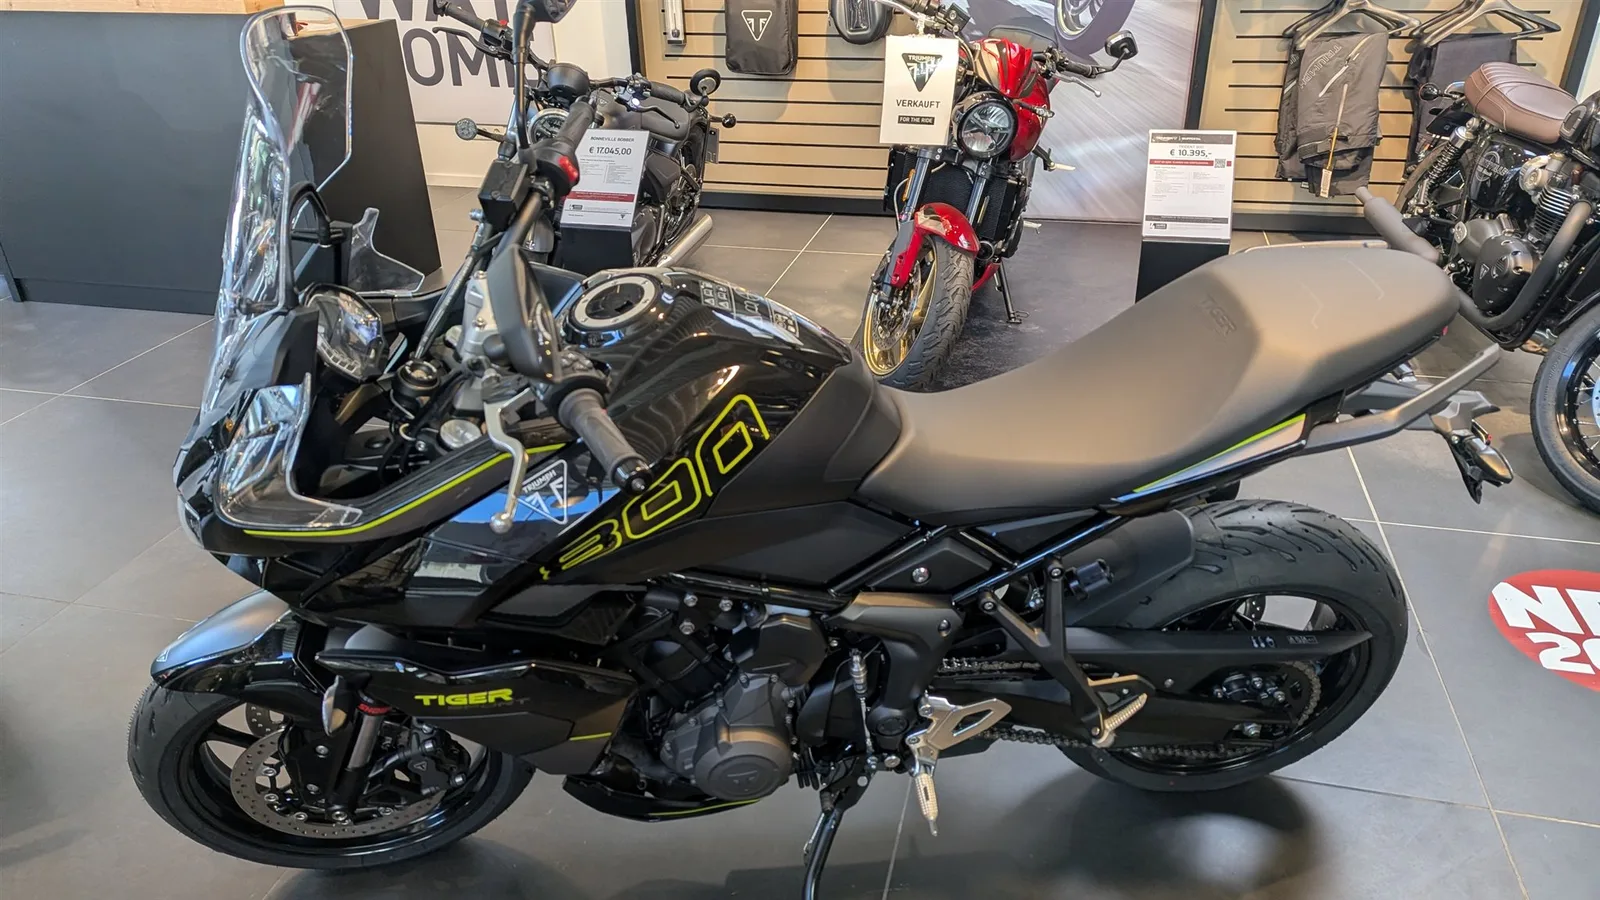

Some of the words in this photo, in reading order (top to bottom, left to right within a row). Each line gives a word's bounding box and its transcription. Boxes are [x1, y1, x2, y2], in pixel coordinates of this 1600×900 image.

[896, 99, 941, 109] VERKAUFT
[596, 147, 632, 155] 17.045,00
[1178, 149, 1212, 158] 10.395,-
[521, 469, 557, 493] TRIUMPH
[414, 688, 513, 706] TIGER
